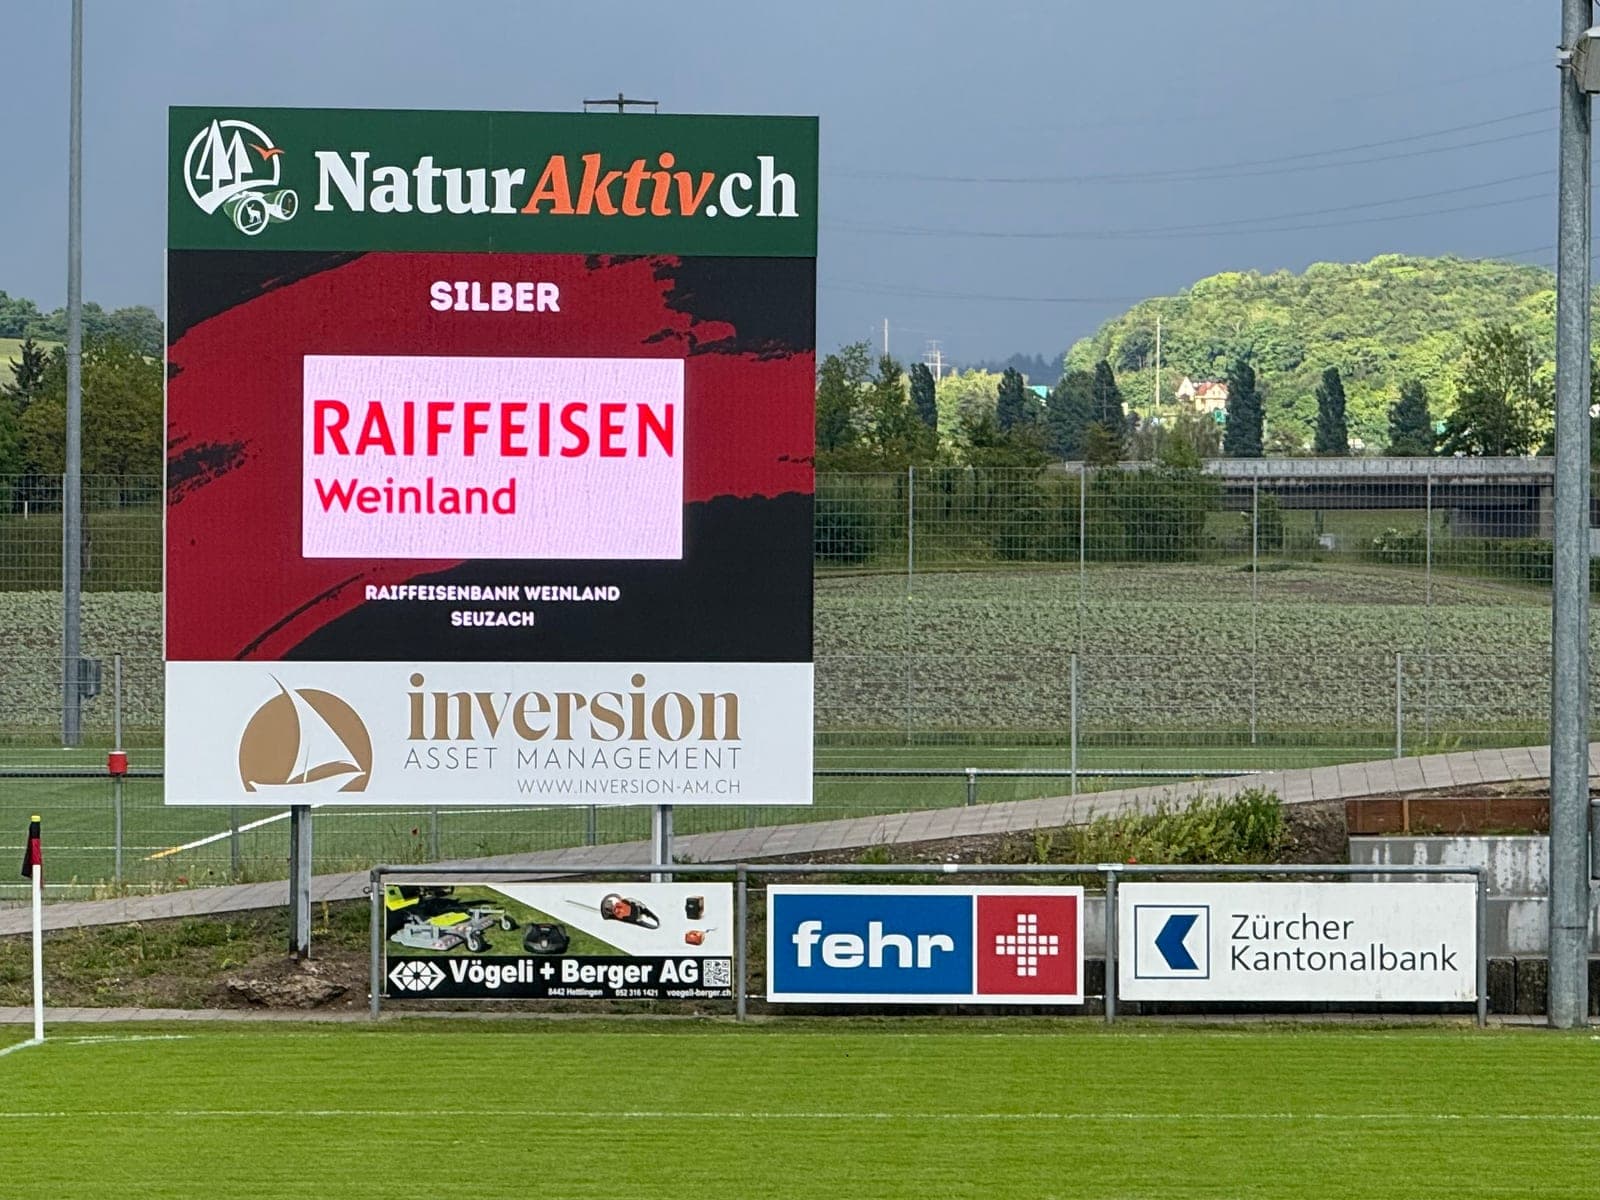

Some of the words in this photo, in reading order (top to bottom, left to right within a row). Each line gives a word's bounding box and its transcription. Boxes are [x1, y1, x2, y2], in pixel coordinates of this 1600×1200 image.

[314, 151, 800, 217] NaturAktiv.ch
[430, 281, 560, 313] SILBER
[313, 400, 675, 459] RAIFFEISEN
[314, 477, 517, 515] Weinland
[365, 584, 520, 602] RAIFFEISENBANK
[524, 585, 621, 602] WEINLAND
[450, 610, 535, 628] SEUZACH
[406, 673, 742, 742] inversion
[404, 747, 498, 770] ASSET
[516, 747, 742, 770] MANAGEMENT
[517, 778, 740, 794] WWW.INVERSION-AM.CH
[1231, 913, 1355, 941] Zürcher
[792, 920, 955, 969] fehr
[1231, 943, 1458, 972] Kantonalbank
[449, 959, 534, 989] Vögeli
[539, 962, 556, 981] +
[561, 960, 653, 988] Berger
[659, 959, 699, 983] AG
[643, 989, 659, 997] 1421
